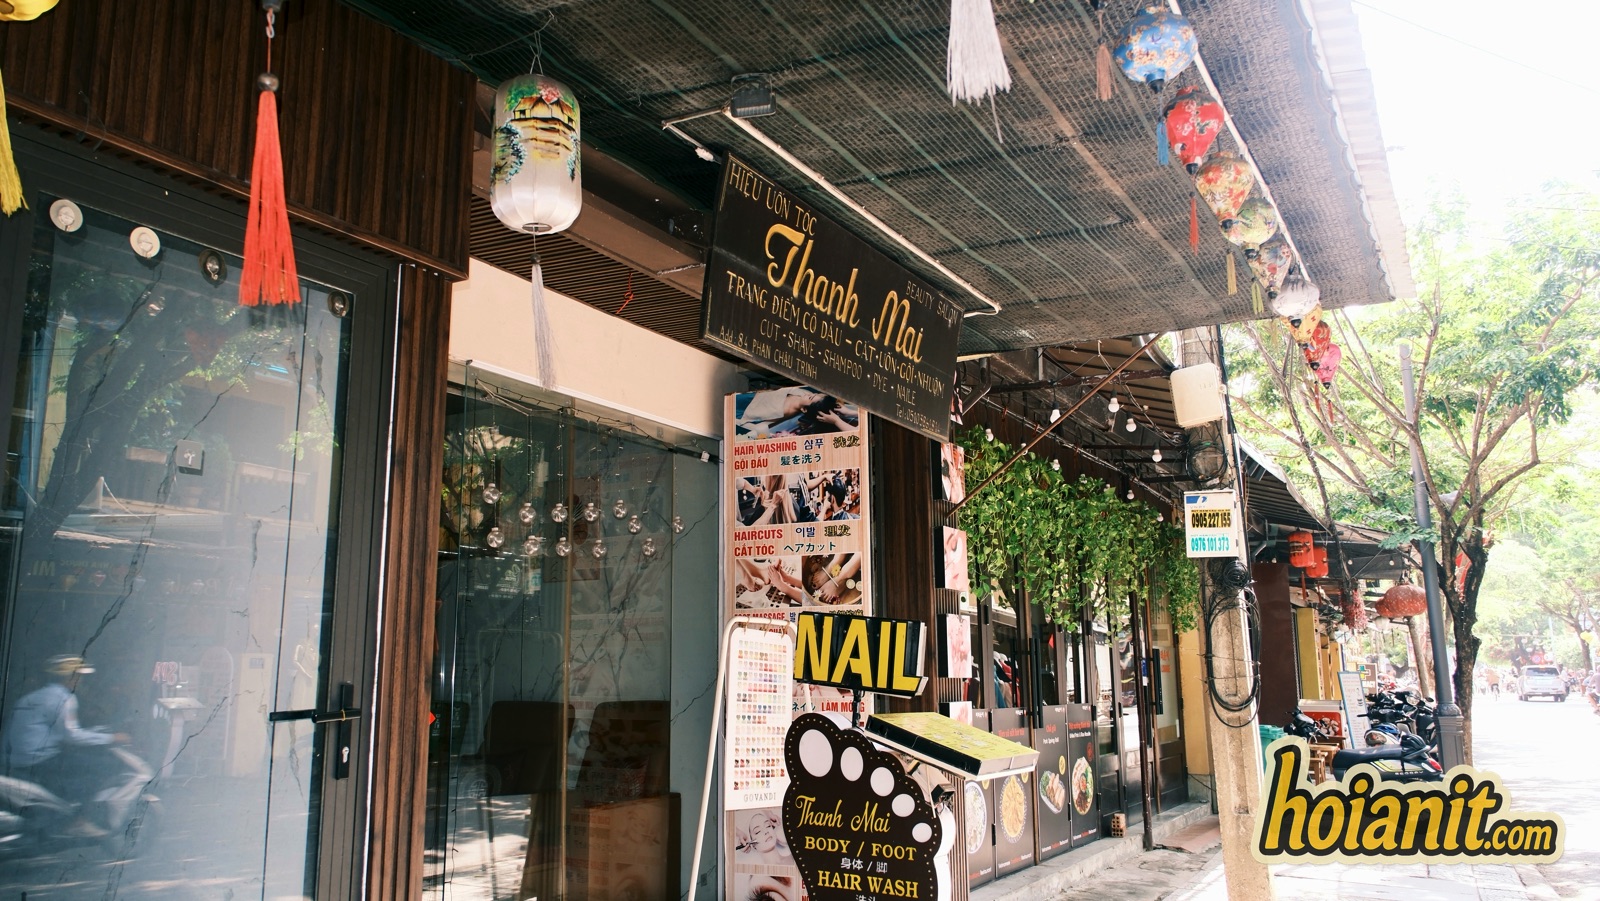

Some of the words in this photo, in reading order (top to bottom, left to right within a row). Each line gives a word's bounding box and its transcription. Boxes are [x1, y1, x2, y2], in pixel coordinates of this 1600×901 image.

[729, 163, 763, 201] HIỆU
[795, 205, 817, 236] TÓC
[726, 270, 768, 309] TRANG
[765, 223, 860, 329] Thanh
[872, 290, 924, 364] Mai
[905, 280, 935, 309] BEAUTY
[936, 300, 959, 325] SALON
[751, 338, 772, 359] PHAN
[796, 358, 818, 380] TRINH
[760, 318, 781, 342] CUT
[787, 331, 816, 359] SHAVE
[822, 349, 863, 380] SHAMPOO
[873, 372, 888, 393] DYE
[734, 445, 754, 456] HAIR
[757, 441, 797, 454] WASHING
[804, 438, 824, 451] 샴푸
[780, 453, 822, 466] 髪を洗う
[1191, 512, 1231, 528] 0905.227.155
[734, 529, 783, 541] HAIRCUTS
[795, 526, 816, 538] 이발
[755, 543, 774, 556] TÓC
[783, 541, 836, 553] ヘアカット
[793, 614, 923, 692] NAIL
[821, 700, 838, 712] LÀM
[840, 700, 865, 713] MÓG
[743, 792, 776, 803] GOVANDI
[794, 795, 844, 829] Thanh
[850, 801, 891, 833] Mai
[804, 835, 850, 854] BODY
[871, 843, 917, 861] FOOT
[840, 857, 863, 871] 身体
[817, 870, 861, 892] HAIR
[867, 875, 919, 899] WASH
